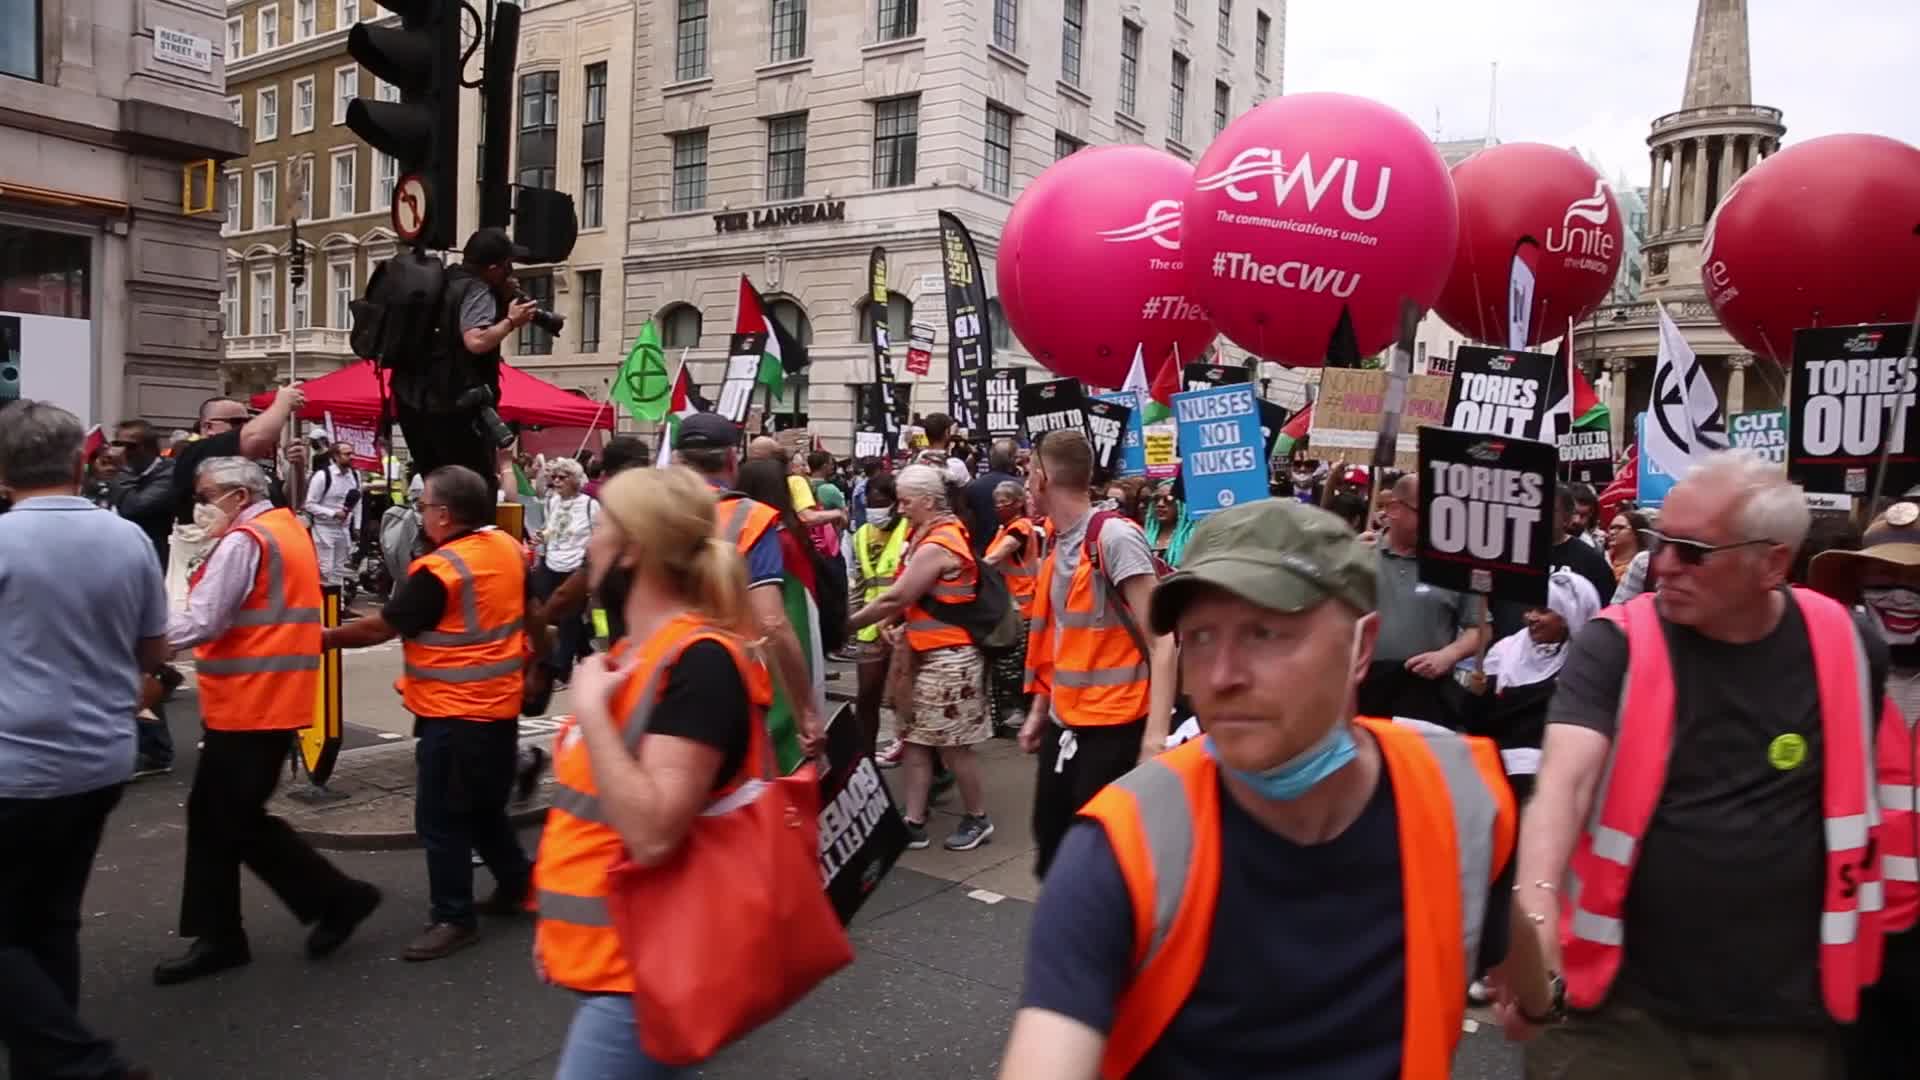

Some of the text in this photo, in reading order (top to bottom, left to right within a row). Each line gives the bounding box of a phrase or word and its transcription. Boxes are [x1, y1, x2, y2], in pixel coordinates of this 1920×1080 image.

[161, 31, 193, 46] REGENT
[161, 42, 192, 56] STREET
[1222, 147, 1392, 220] CWU
[713, 201, 846, 233] THE LANGHAM
[1216, 210, 1378, 246] The communications union
[1149, 259, 1169, 270] The
[1212, 252, 1361, 298] #TheCWU
[1142, 296, 1208, 320] #The
[986, 379, 1019, 395] KILL
[1805, 357, 1918, 395] TORIES
[1460, 372, 1539, 408] TORIES
[986, 395, 1020, 412] THE
[1179, 391, 1252, 420] NURSES
[987, 412, 1020, 430] BILL
[1048, 411, 1067, 431] FIT
[1066, 408, 1084, 428] TO
[1452, 400, 1534, 439] OUT
[1734, 413, 1783, 431] CUT
[1803, 393, 1916, 456] OUT
[1200, 422, 1238, 446] NOT
[1733, 430, 1785, 449] WAR
[1193, 448, 1254, 473] NUKES
[1560, 443, 1610, 461] GOVERN
[1757, 446, 1785, 463] OT
[1429, 460, 1544, 507] TORIES
[1430, 496, 1541, 564] OUT
